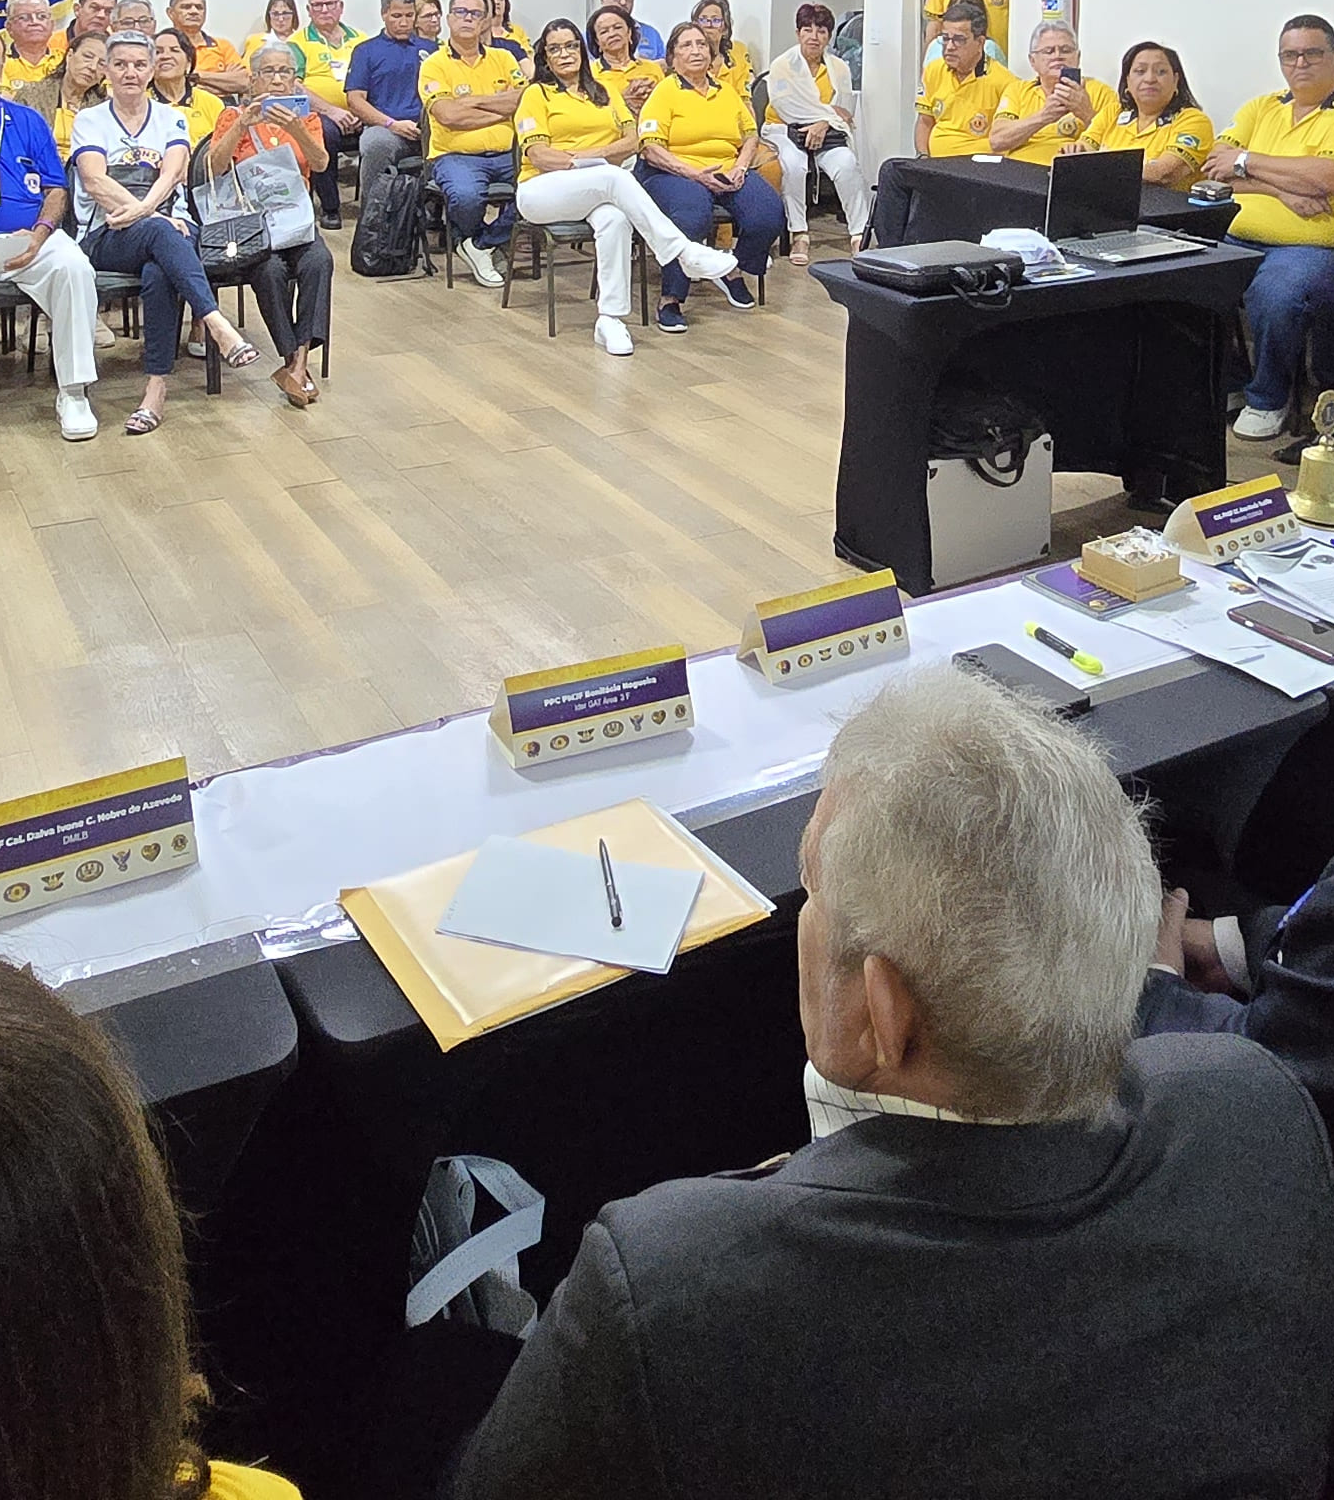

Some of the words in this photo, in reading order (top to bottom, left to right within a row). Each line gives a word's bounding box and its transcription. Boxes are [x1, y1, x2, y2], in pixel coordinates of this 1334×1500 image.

[543, 696, 561, 707] PPC
[26, 827, 56, 842] Dalva
[56, 820, 84, 833] Ivone
[85, 816, 96, 825] C.
[97, 809, 127, 823] Nobre
[128, 804, 141, 815] de
[142, 793, 183, 811] Azevedo
